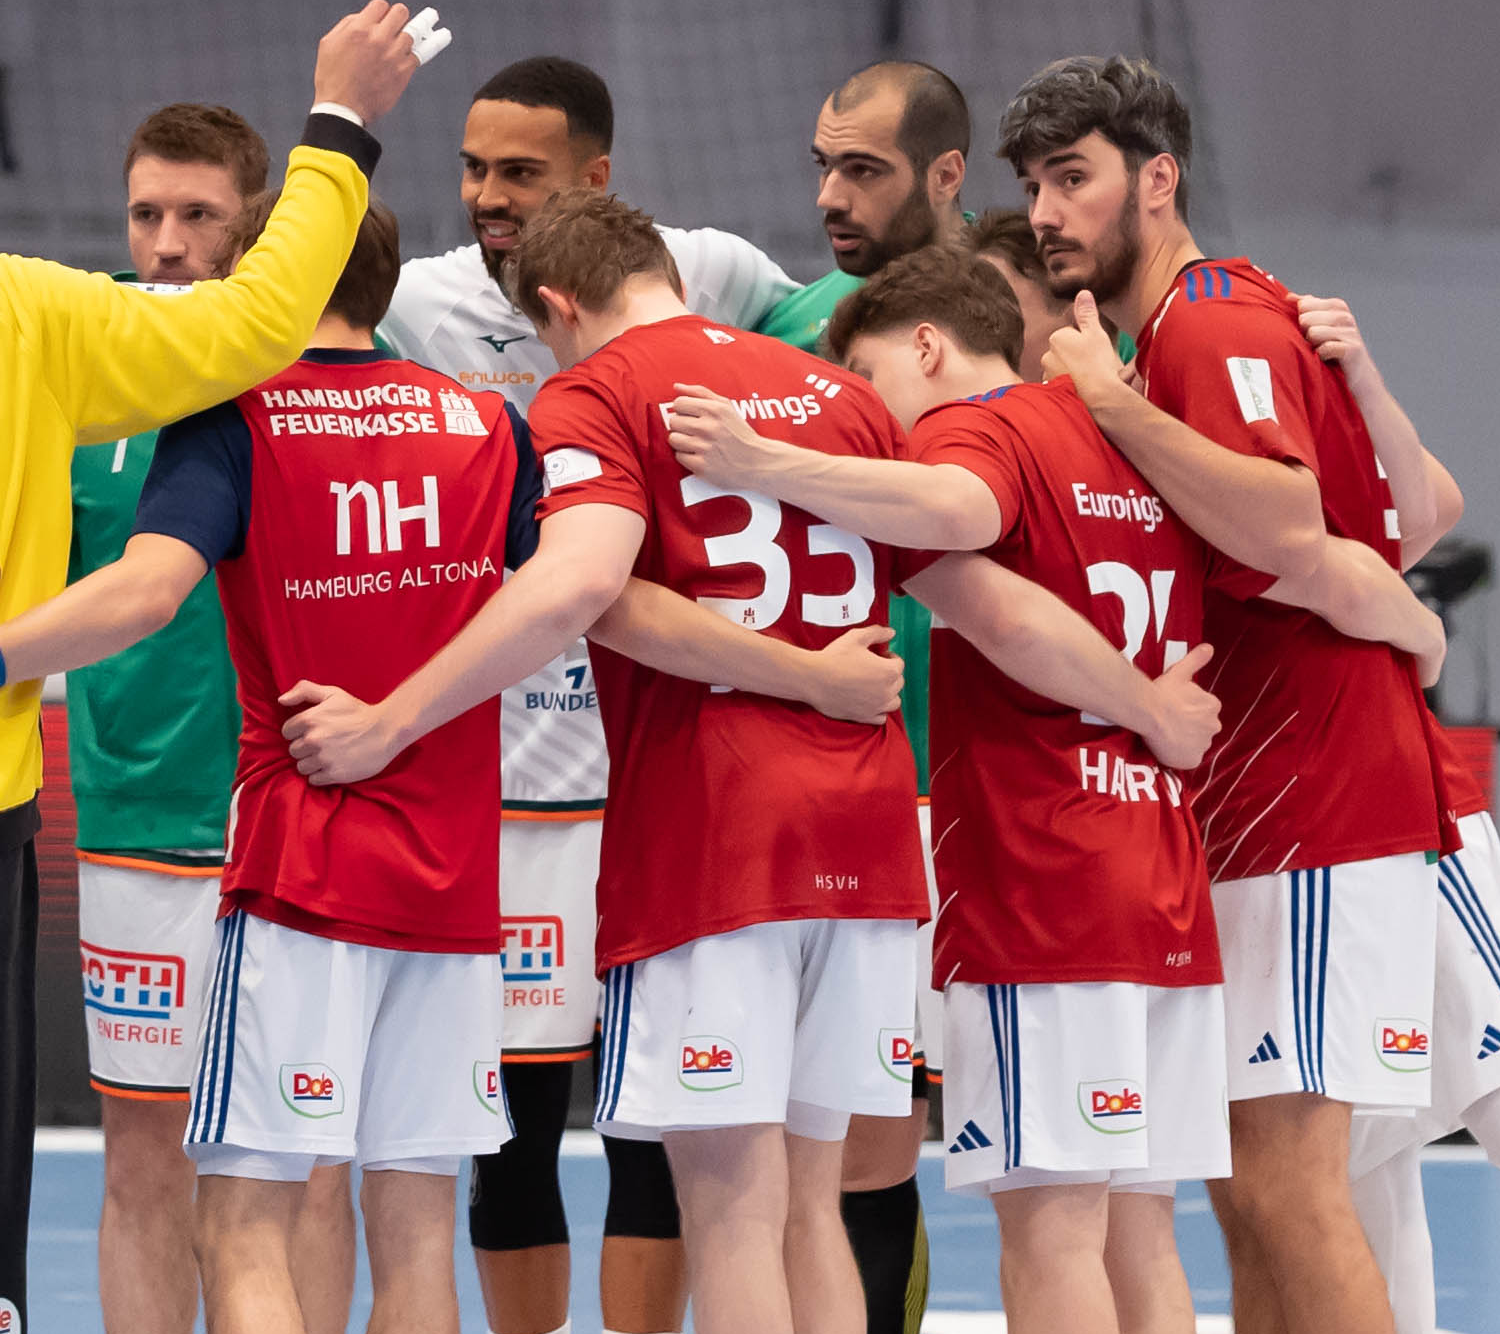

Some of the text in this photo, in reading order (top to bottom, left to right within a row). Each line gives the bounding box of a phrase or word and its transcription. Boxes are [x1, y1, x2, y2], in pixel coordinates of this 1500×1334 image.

[262, 383, 433, 411] HAMBURGER
[269, 412, 439, 438] FEUERKASSE
[284, 555, 498, 601] HAMBURG ALTONA
[525, 691, 598, 712] BUNDE
[814, 873, 860, 892] HSVH
[81, 954, 172, 1008] OTH
[1382, 1027, 1429, 1053] Dole
[682, 1044, 734, 1072] Dole
[293, 1071, 334, 1097] Dole
[1091, 1087, 1143, 1113] Dole
